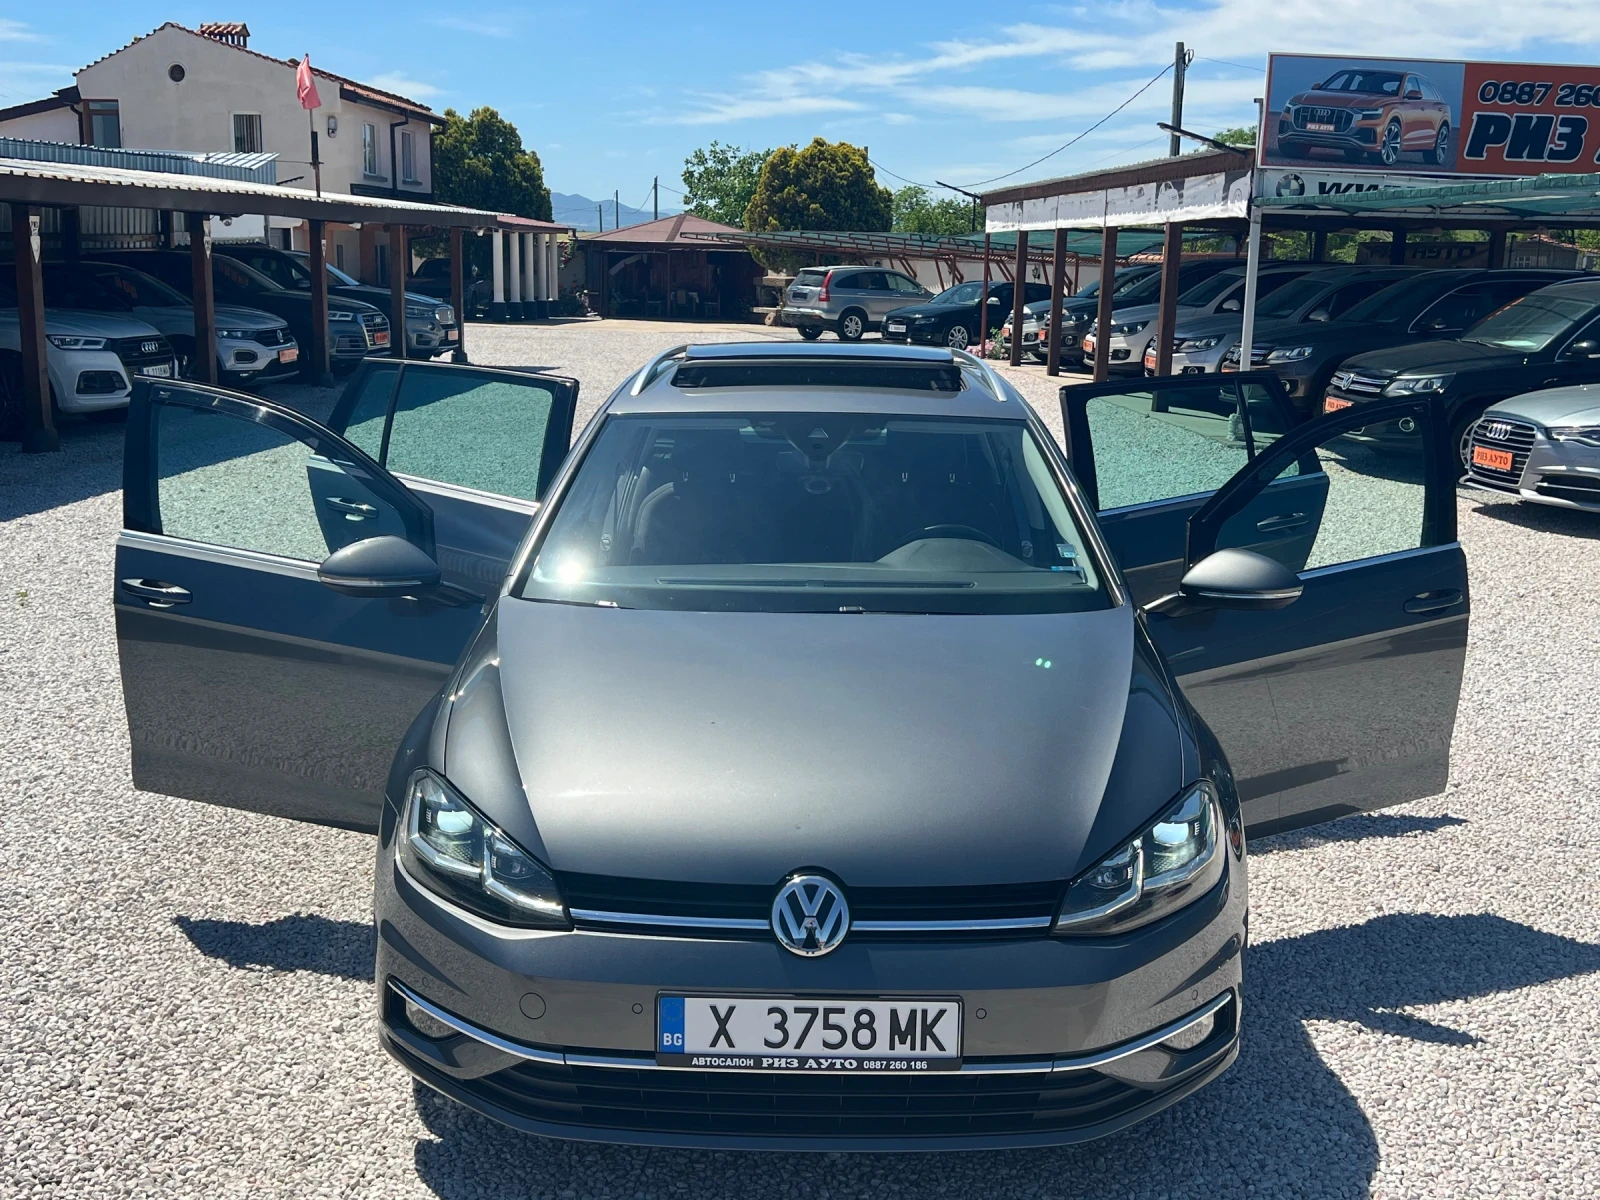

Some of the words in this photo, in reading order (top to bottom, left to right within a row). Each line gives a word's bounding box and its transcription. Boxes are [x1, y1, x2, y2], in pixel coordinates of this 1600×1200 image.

[1477, 80, 1553, 106] 0887
[1463, 111, 1589, 163] РИЗ
[1488, 453, 1509, 466] АУТО
[709, 1005, 736, 1049] X
[763, 1007, 877, 1051] 3758
[888, 1008, 948, 1052] MK
[663, 1033, 683, 1046] BG
[691, 1057, 754, 1067] АВТОСАЛОН
[761, 1057, 799, 1068] РИЗ
[804, 1058, 858, 1069] АУТО
[863, 1060, 887, 1070] 0887
[889, 1061, 908, 1070] 260
[910, 1061, 928, 1070] 186
